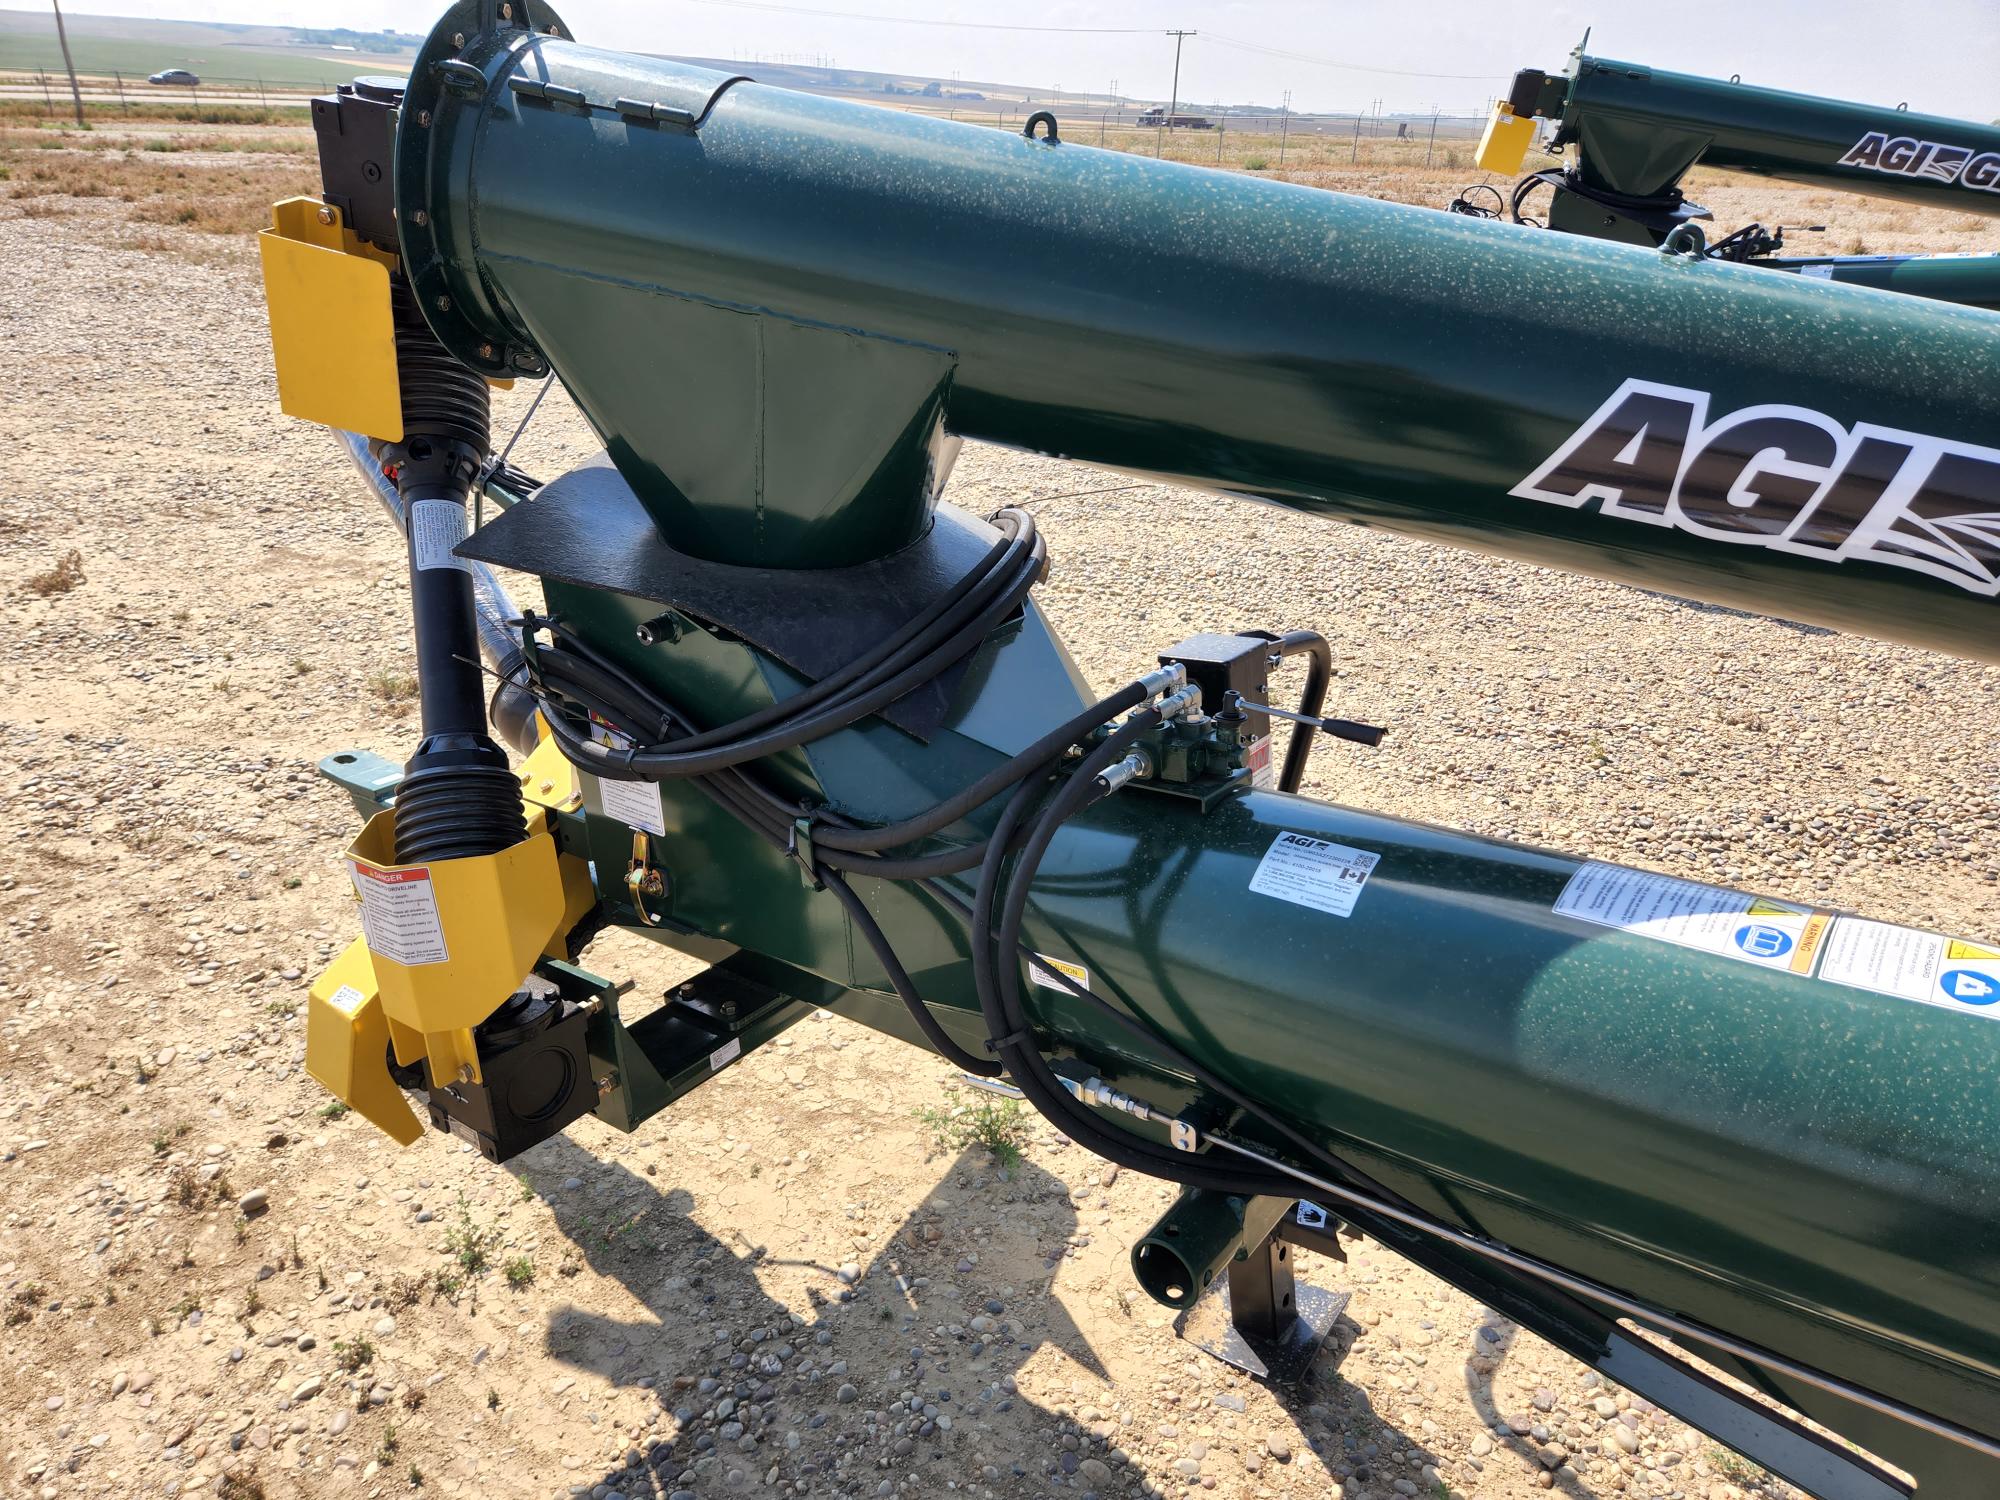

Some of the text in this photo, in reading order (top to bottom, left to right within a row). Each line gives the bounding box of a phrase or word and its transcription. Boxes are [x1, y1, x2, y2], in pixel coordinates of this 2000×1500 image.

[1839, 132, 1935, 176] AGI
[1512, 380, 1922, 560] AGI
[1282, 834, 1316, 847] AGI
[1801, 923, 1820, 951] WARNING
